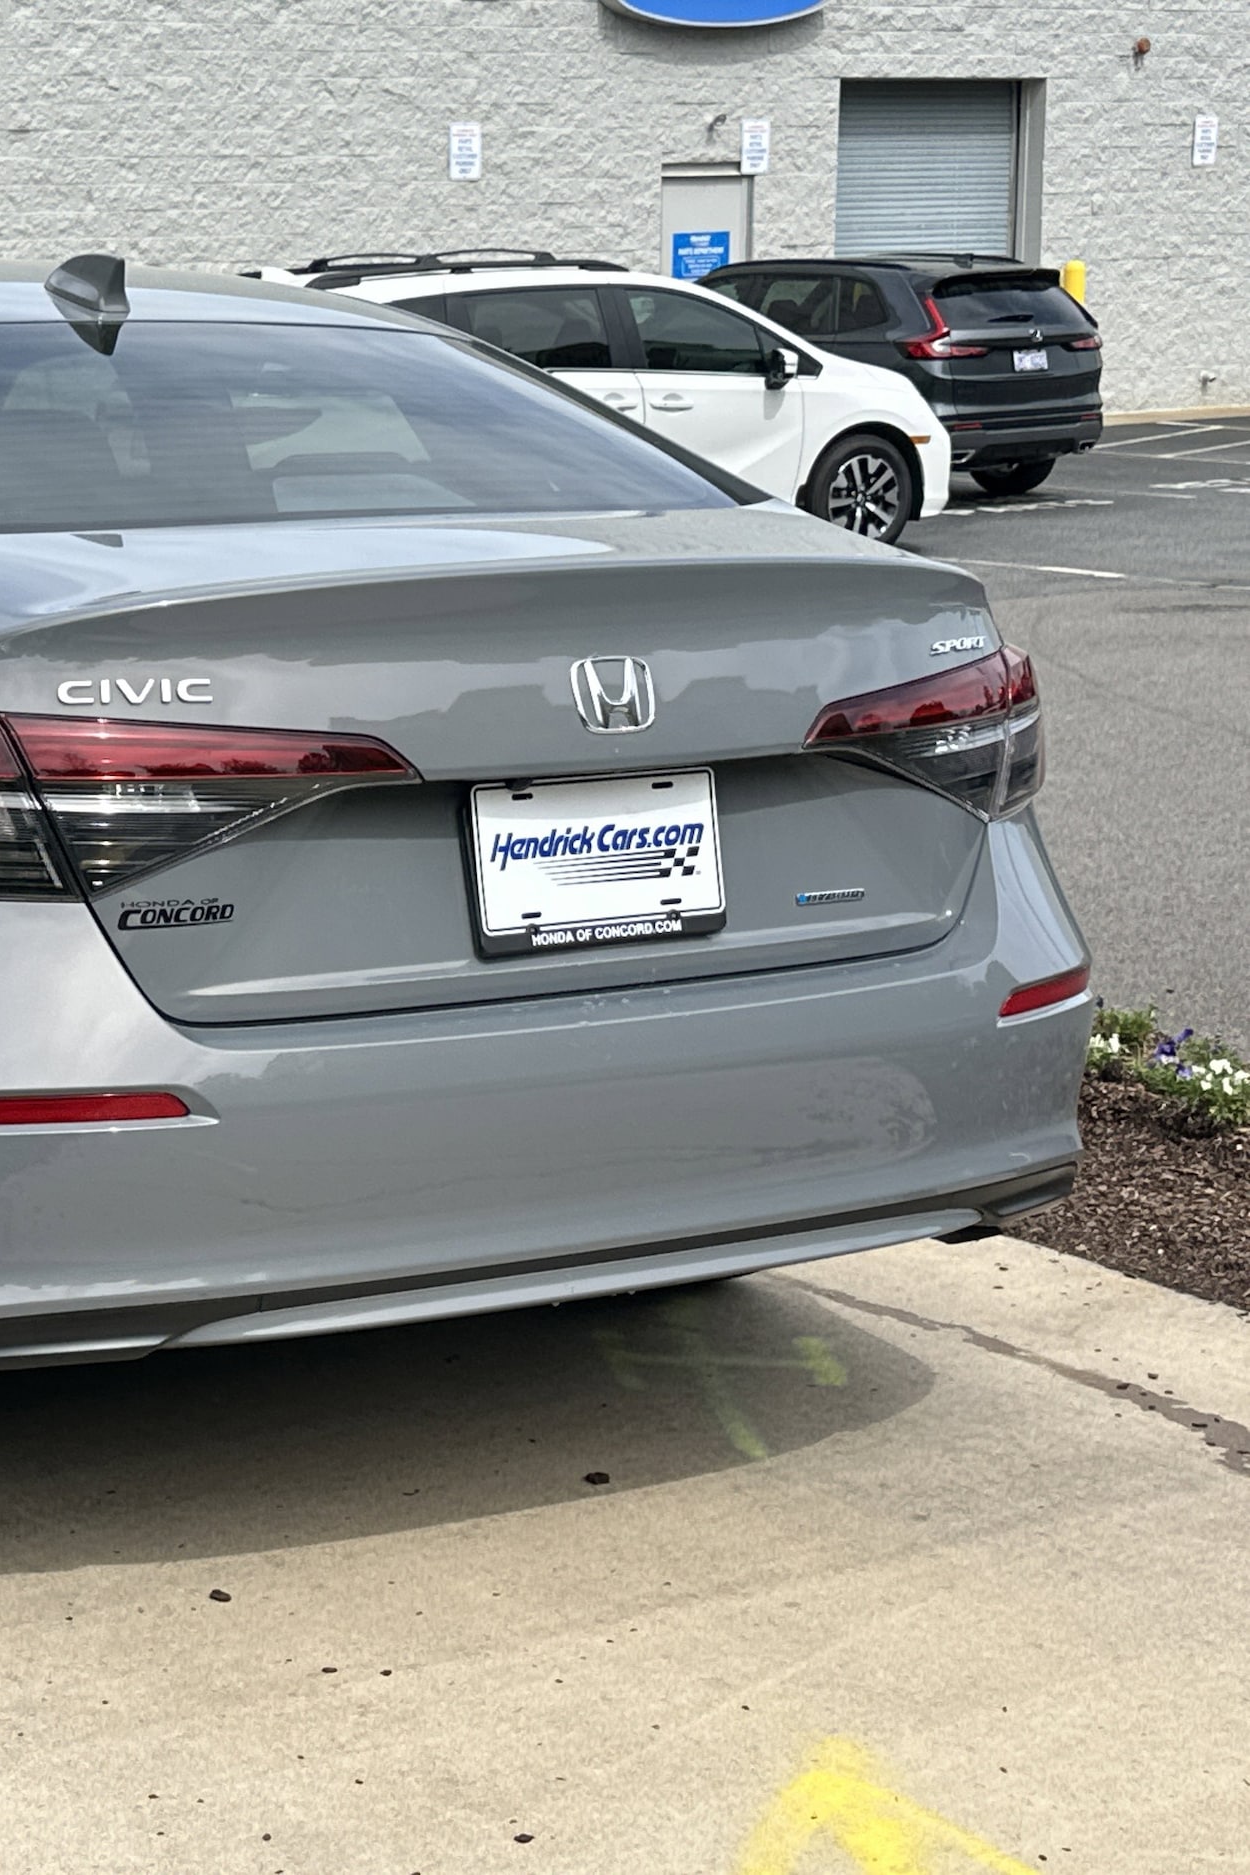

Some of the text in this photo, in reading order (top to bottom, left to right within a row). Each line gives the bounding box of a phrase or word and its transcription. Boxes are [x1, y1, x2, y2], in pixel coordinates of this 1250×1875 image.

[930, 635, 987, 656] SPORT
[57, 678, 214, 705] CIVIC
[121, 897, 219, 909] HONDA OF
[117, 904, 235, 931] CONCORD
[531, 919, 683, 947] HONDA OF CONCORD.COM
